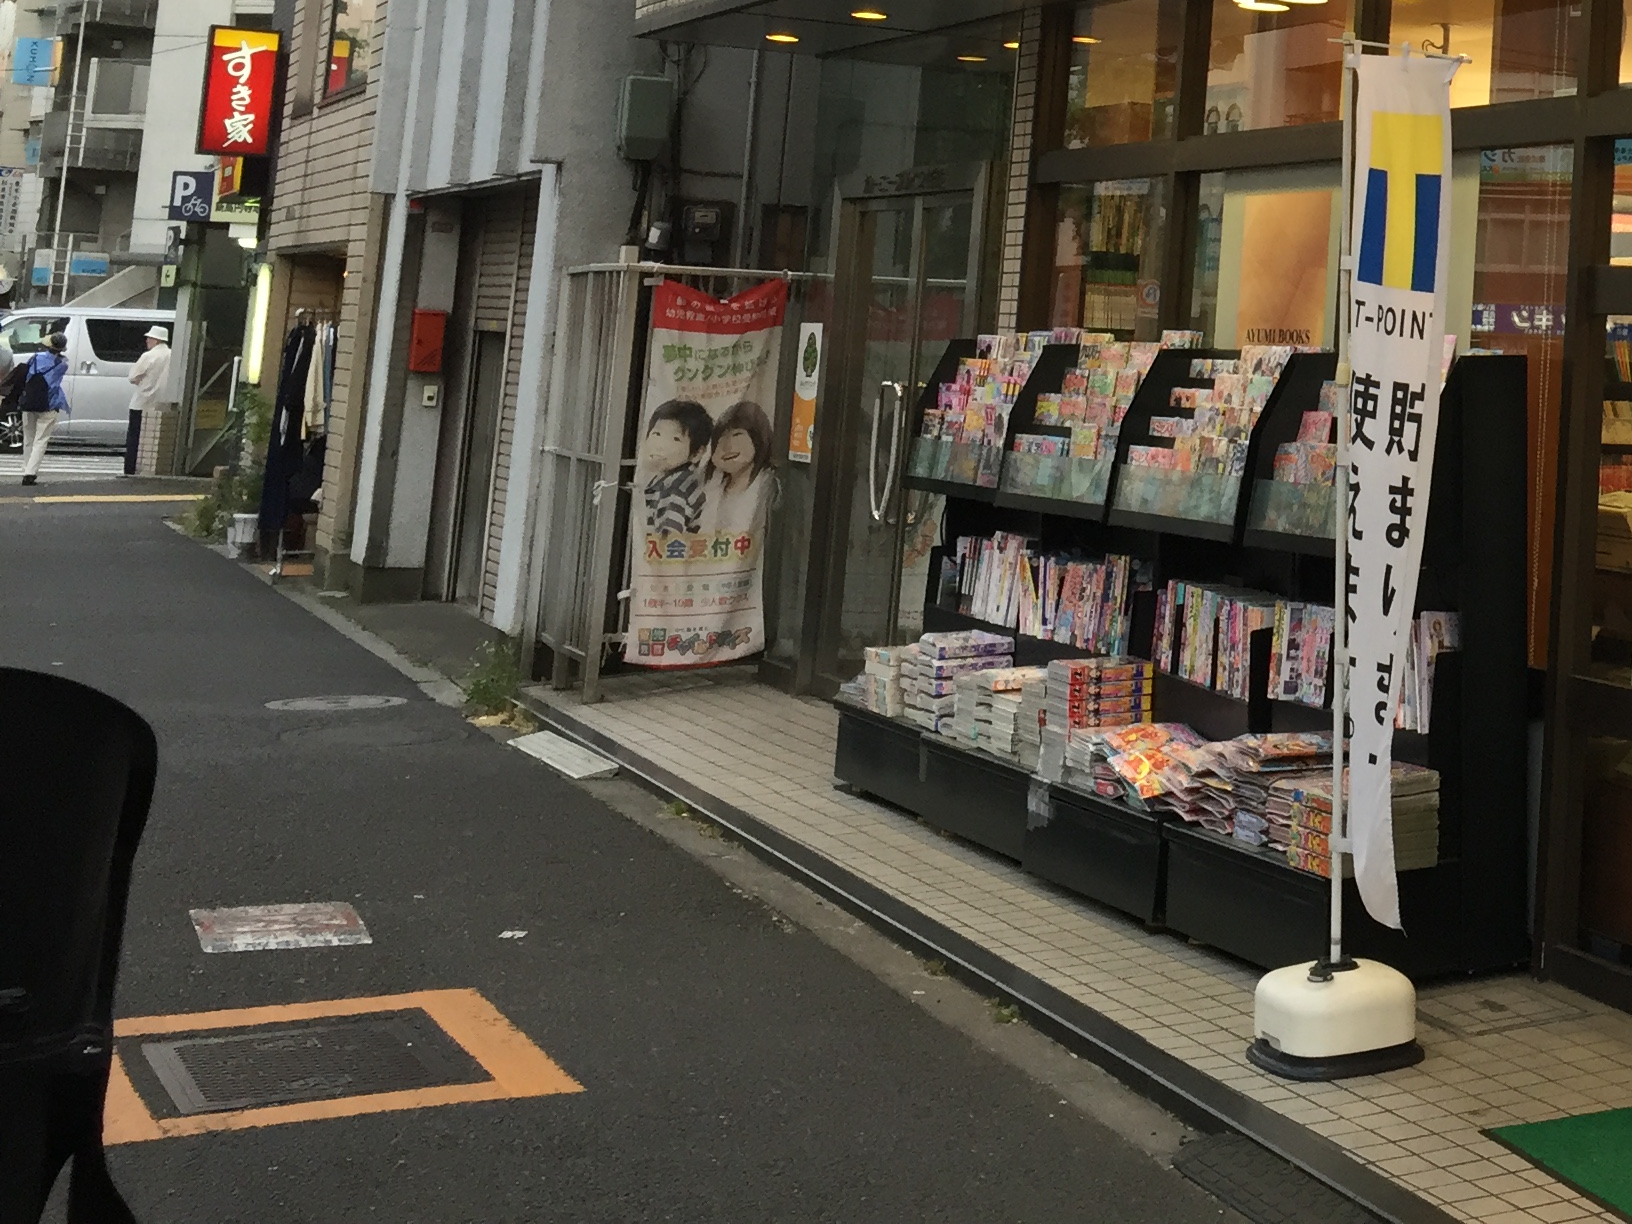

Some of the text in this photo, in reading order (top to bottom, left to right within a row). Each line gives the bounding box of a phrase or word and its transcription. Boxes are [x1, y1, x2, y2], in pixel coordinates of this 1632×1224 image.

[221, 39, 268, 149] すき家
[173, 175, 196, 207] P
[1355, 299, 1434, 340] T-POIN
[1245, 328, 1311, 346] AYUMI BOOKS
[647, 535, 751, 560] 入会受付中
